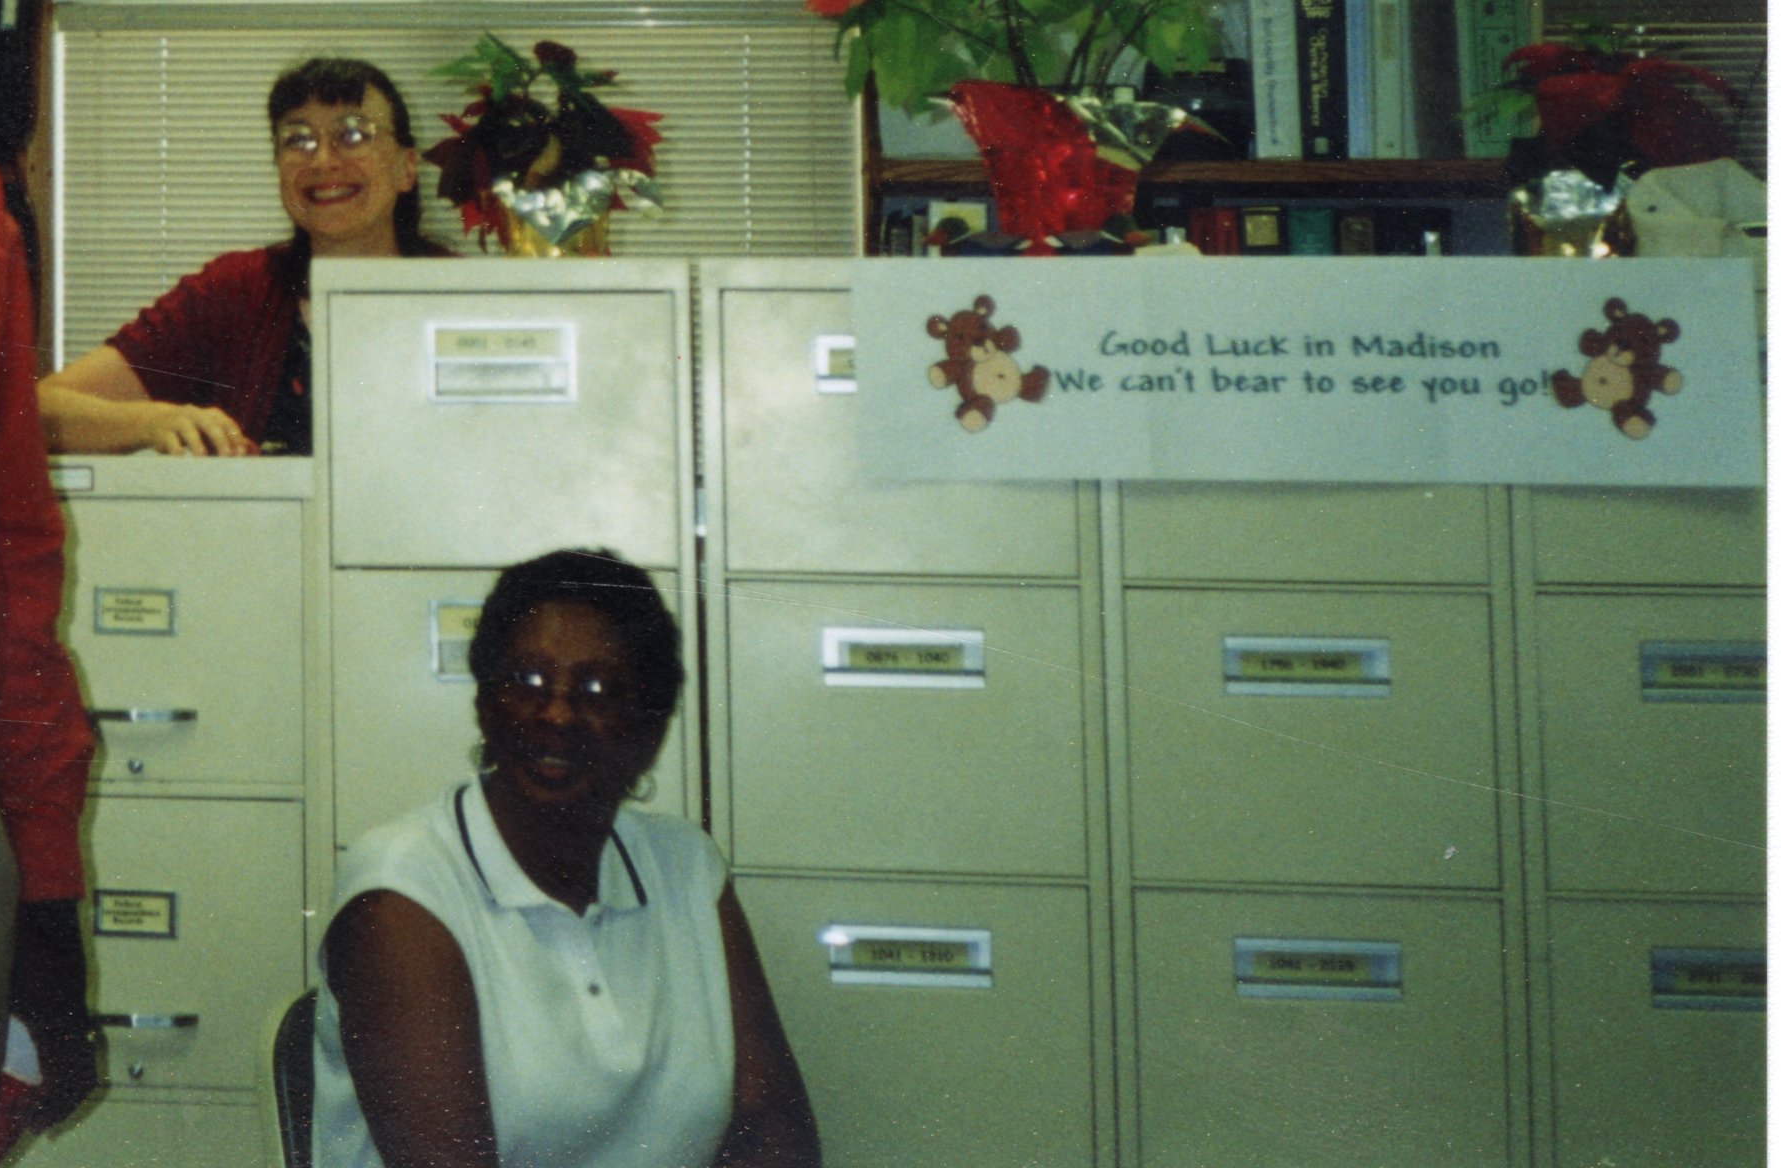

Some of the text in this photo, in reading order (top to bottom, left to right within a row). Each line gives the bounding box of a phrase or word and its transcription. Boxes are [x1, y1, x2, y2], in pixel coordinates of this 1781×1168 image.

[1100, 330, 1500, 358] Good Luck in Madison
[1055, 366, 1549, 406] We can't bear to see you go!
